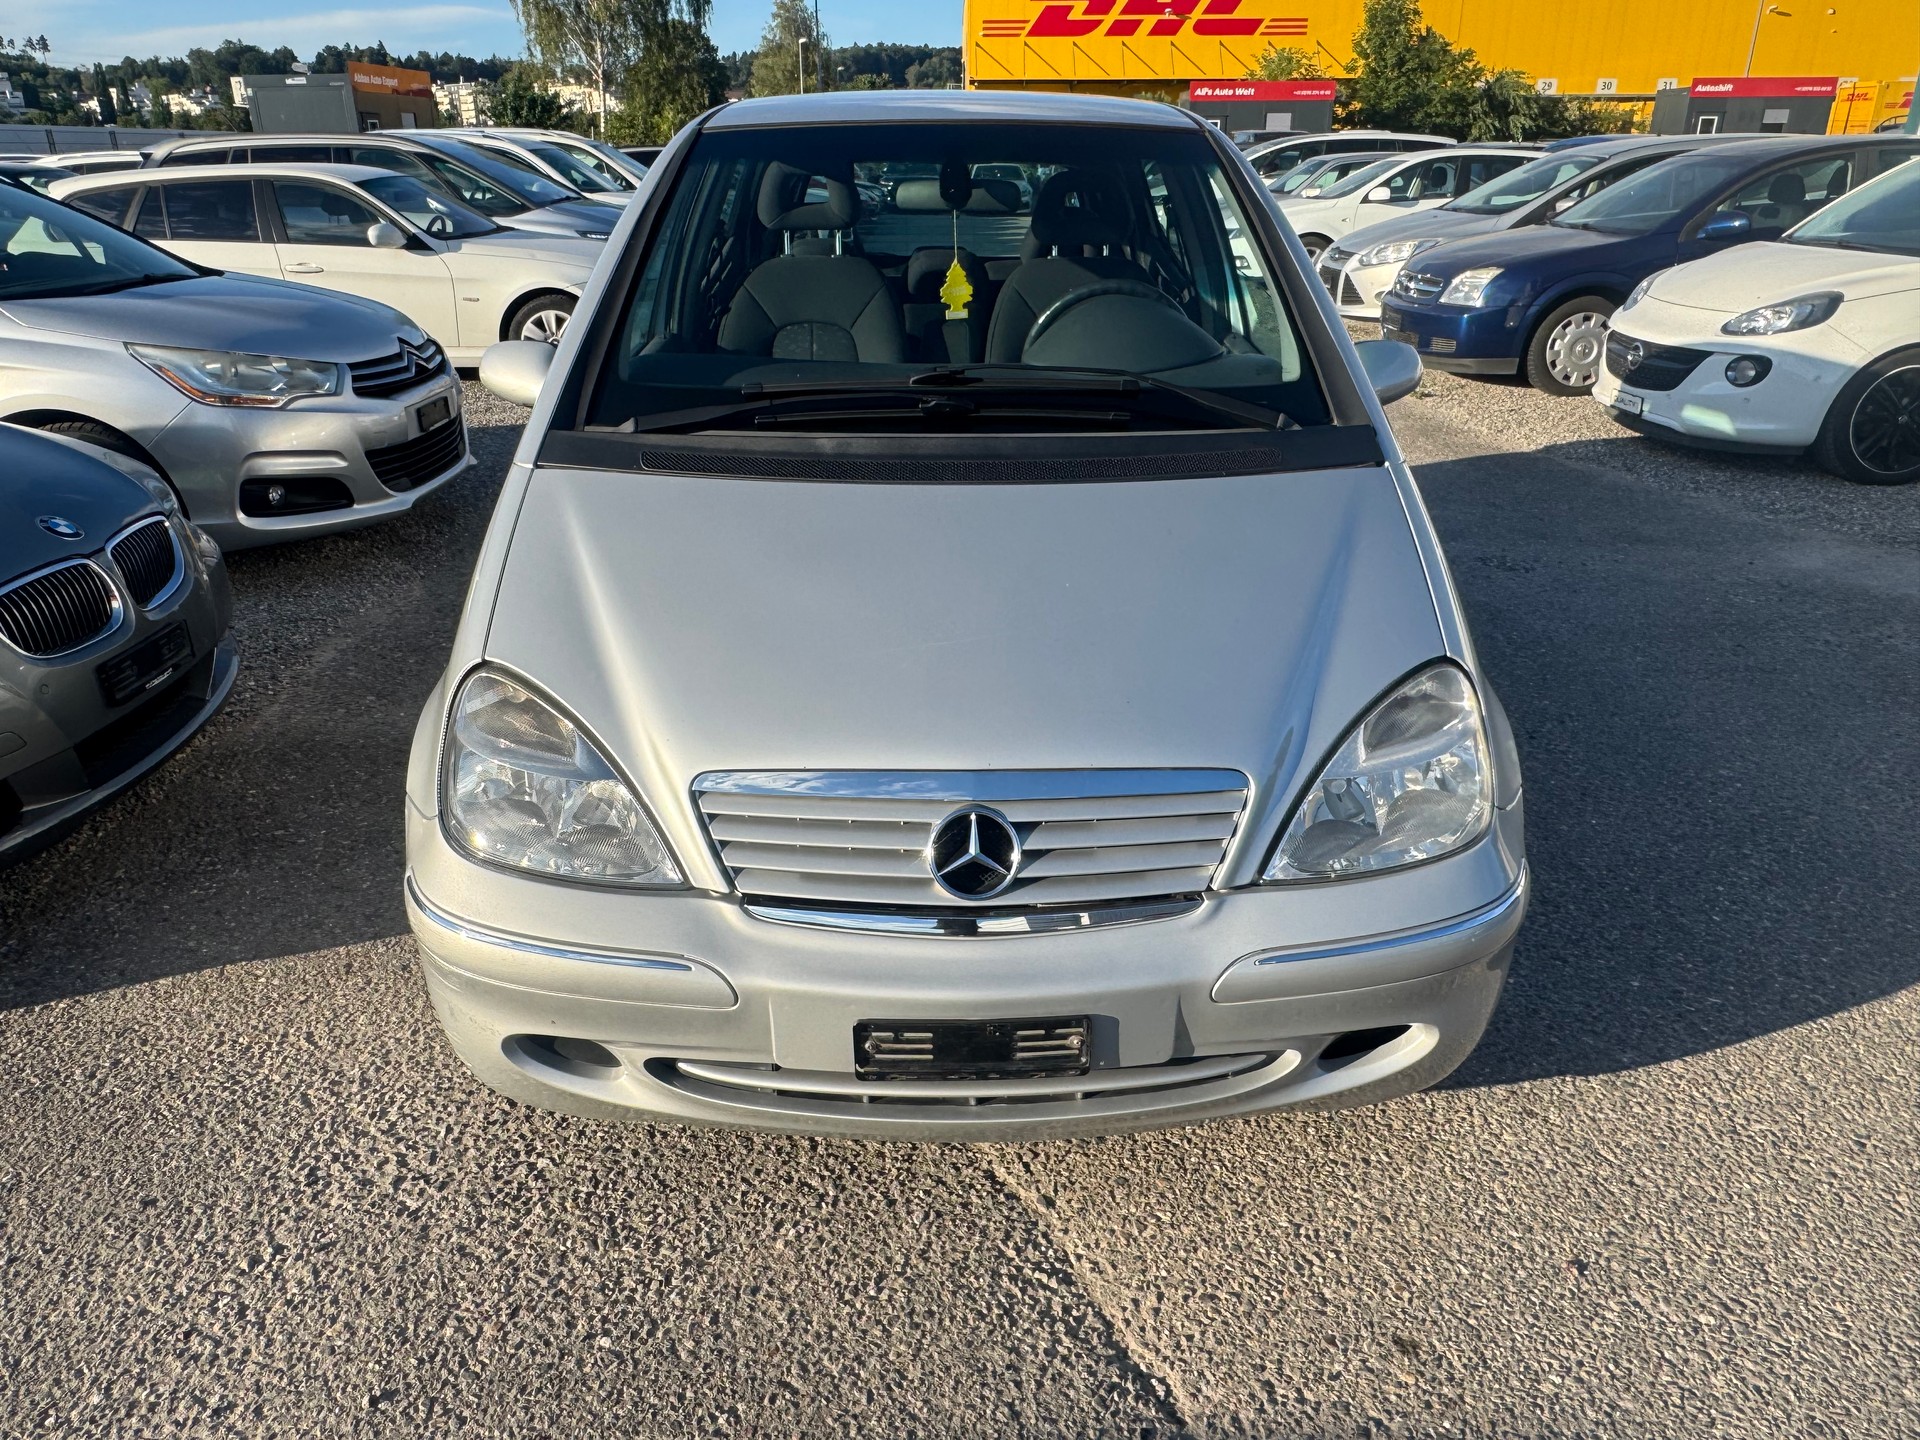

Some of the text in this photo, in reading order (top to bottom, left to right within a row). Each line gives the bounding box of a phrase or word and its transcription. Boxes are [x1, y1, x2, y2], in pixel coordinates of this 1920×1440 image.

[1025, 0, 1266, 37] DHL
[370, 75, 382, 85] Auto
[382, 76, 398, 87] Export
[1541, 81, 1553, 91] 29
[1601, 81, 1613, 91] 30
[1663, 81, 1673, 90] 31
[1213, 87, 1234, 96] Auto
[1235, 87, 1255, 96] Welt
[1694, 84, 1734, 92] Autoshift
